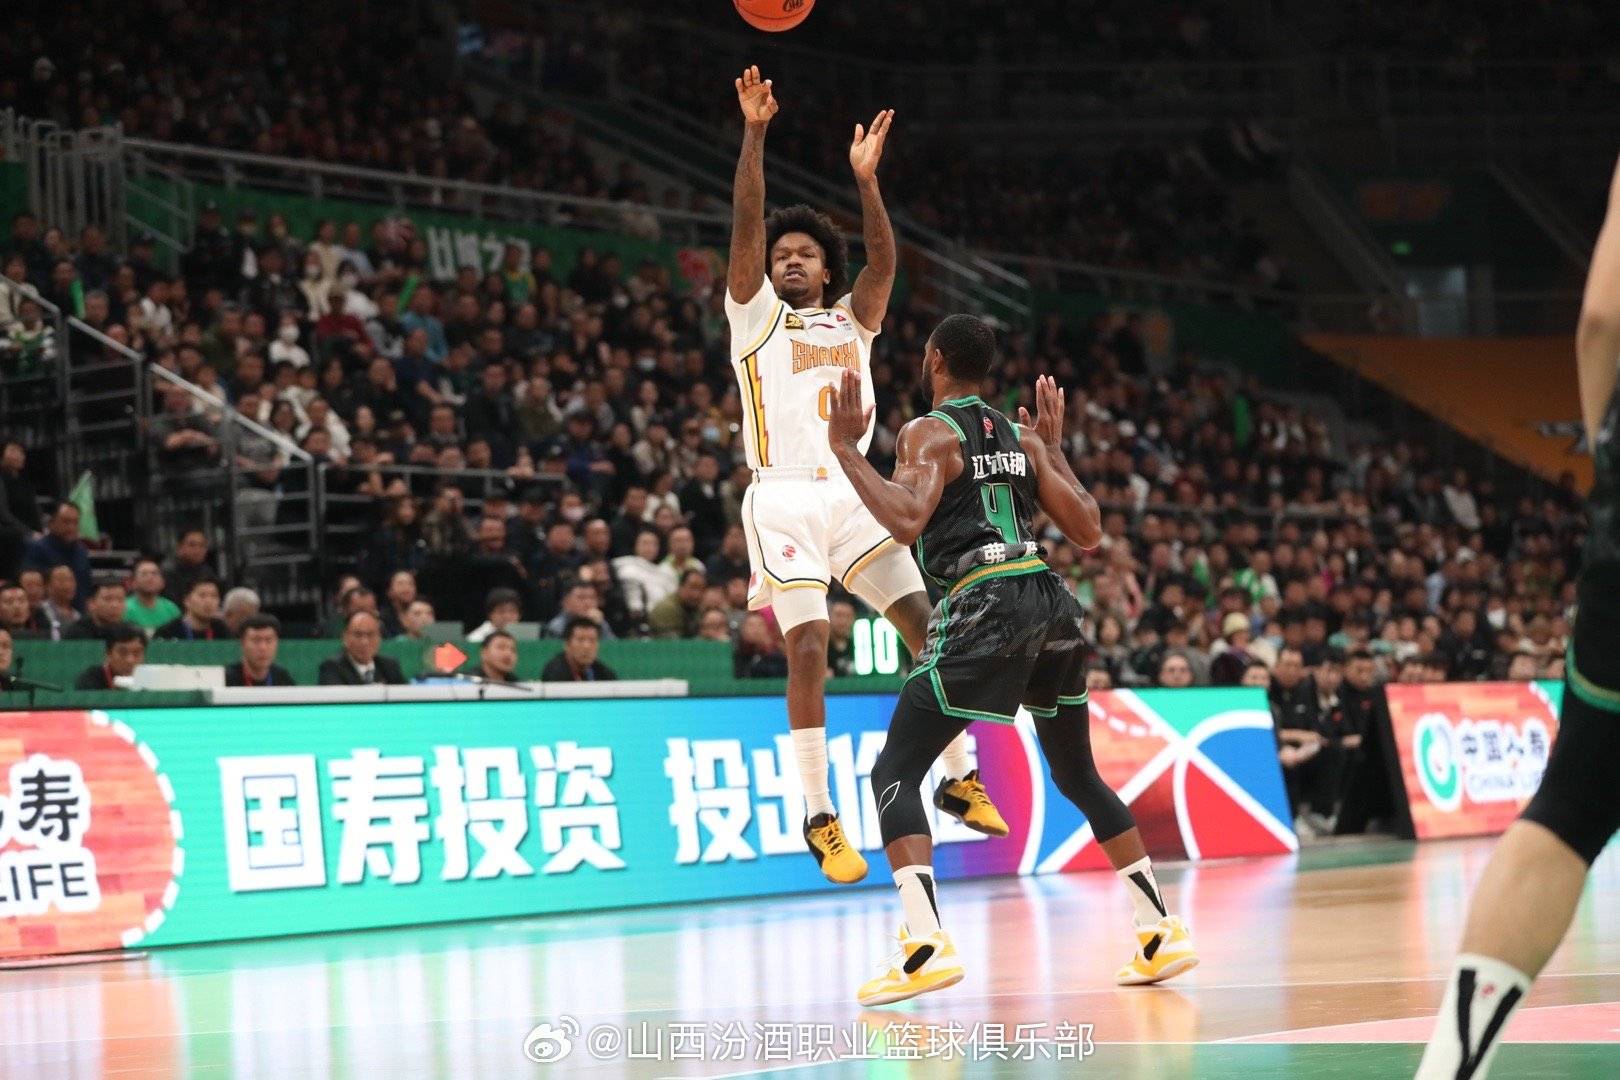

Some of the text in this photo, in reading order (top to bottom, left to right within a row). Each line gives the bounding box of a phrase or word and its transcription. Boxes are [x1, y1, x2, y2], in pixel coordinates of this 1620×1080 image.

[791, 338, 860, 375] SHANXI
[981, 482, 1021, 544] 4
[0, 768, 79, 841] 寿
[219, 741, 627, 893] 国寿投资
[0, 862, 88, 902] IFE
